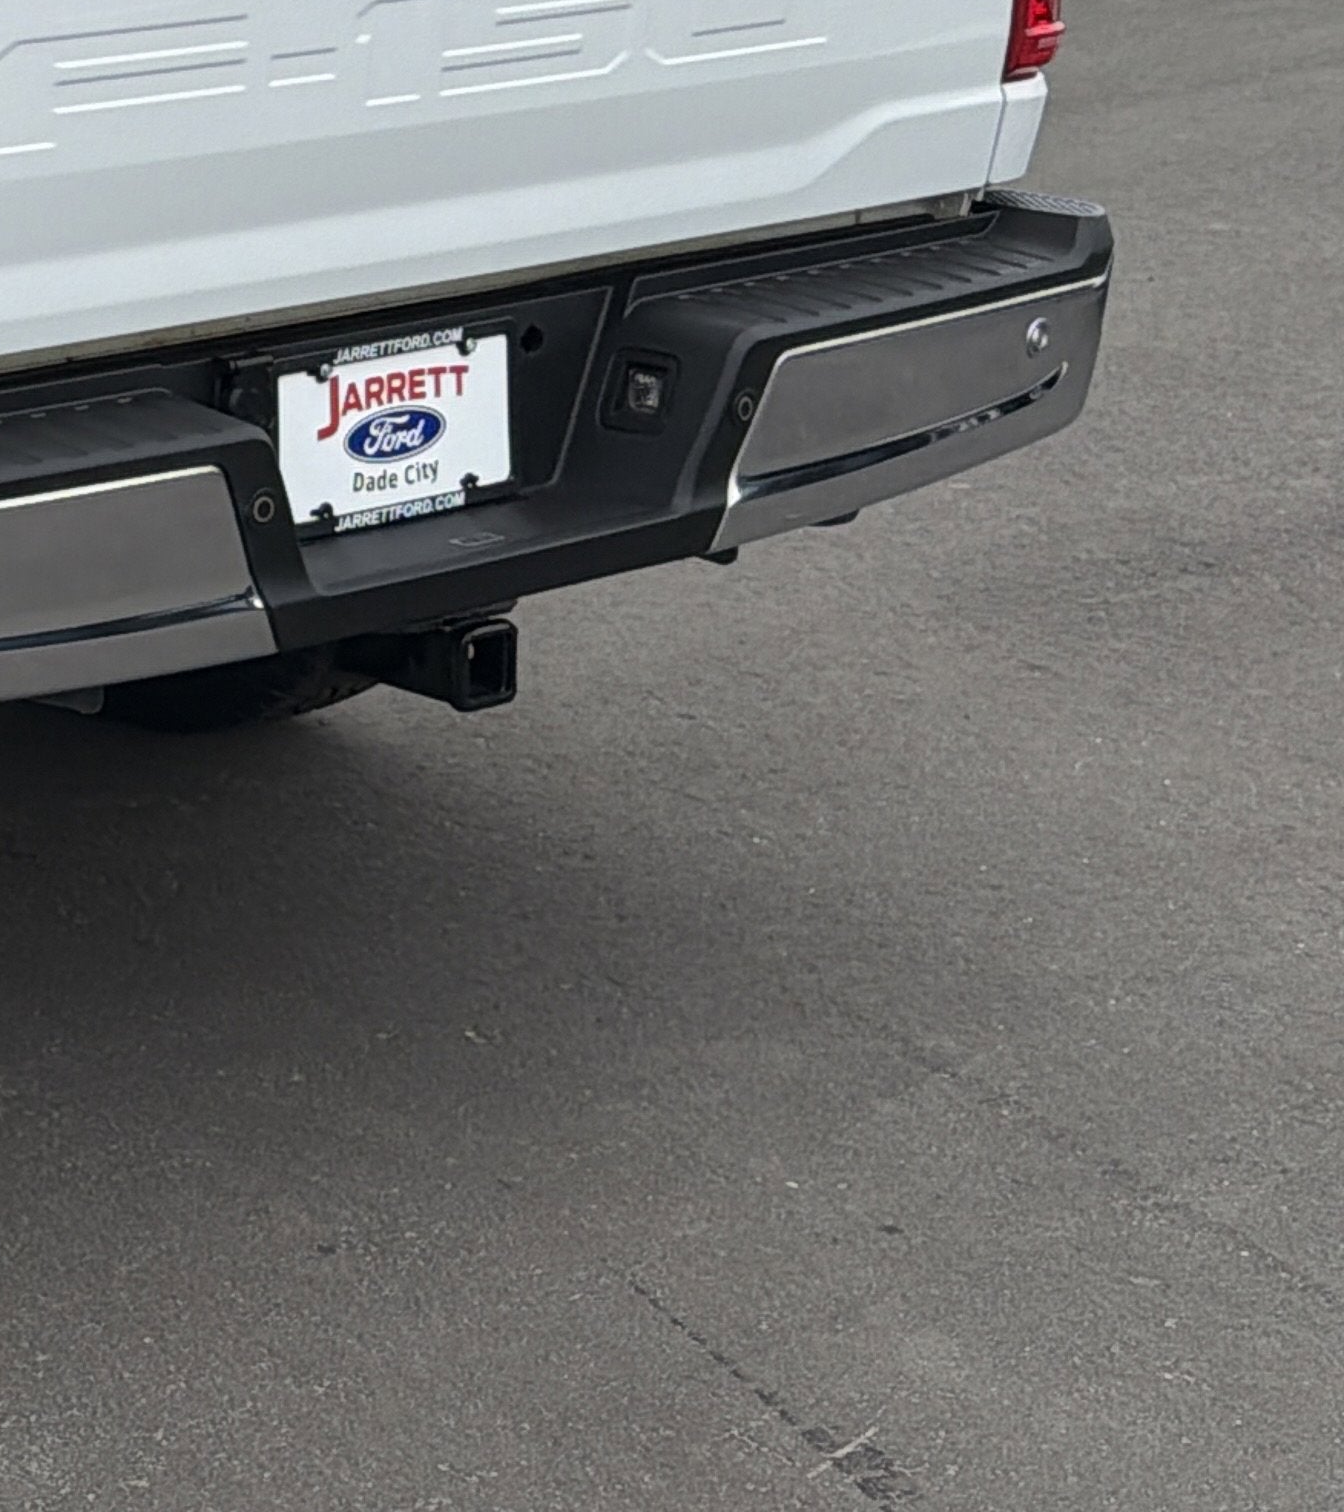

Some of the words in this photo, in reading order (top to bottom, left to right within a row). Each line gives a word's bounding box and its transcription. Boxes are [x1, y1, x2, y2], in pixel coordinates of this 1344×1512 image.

[333, 327, 464, 365] JARRETTFORD.COM
[317, 364, 469, 441] JARRETT
[363, 414, 426, 456] Ford
[352, 471, 399, 492] Dade
[404, 460, 440, 486] City
[333, 491, 466, 532] JARRETTFORD.COM
